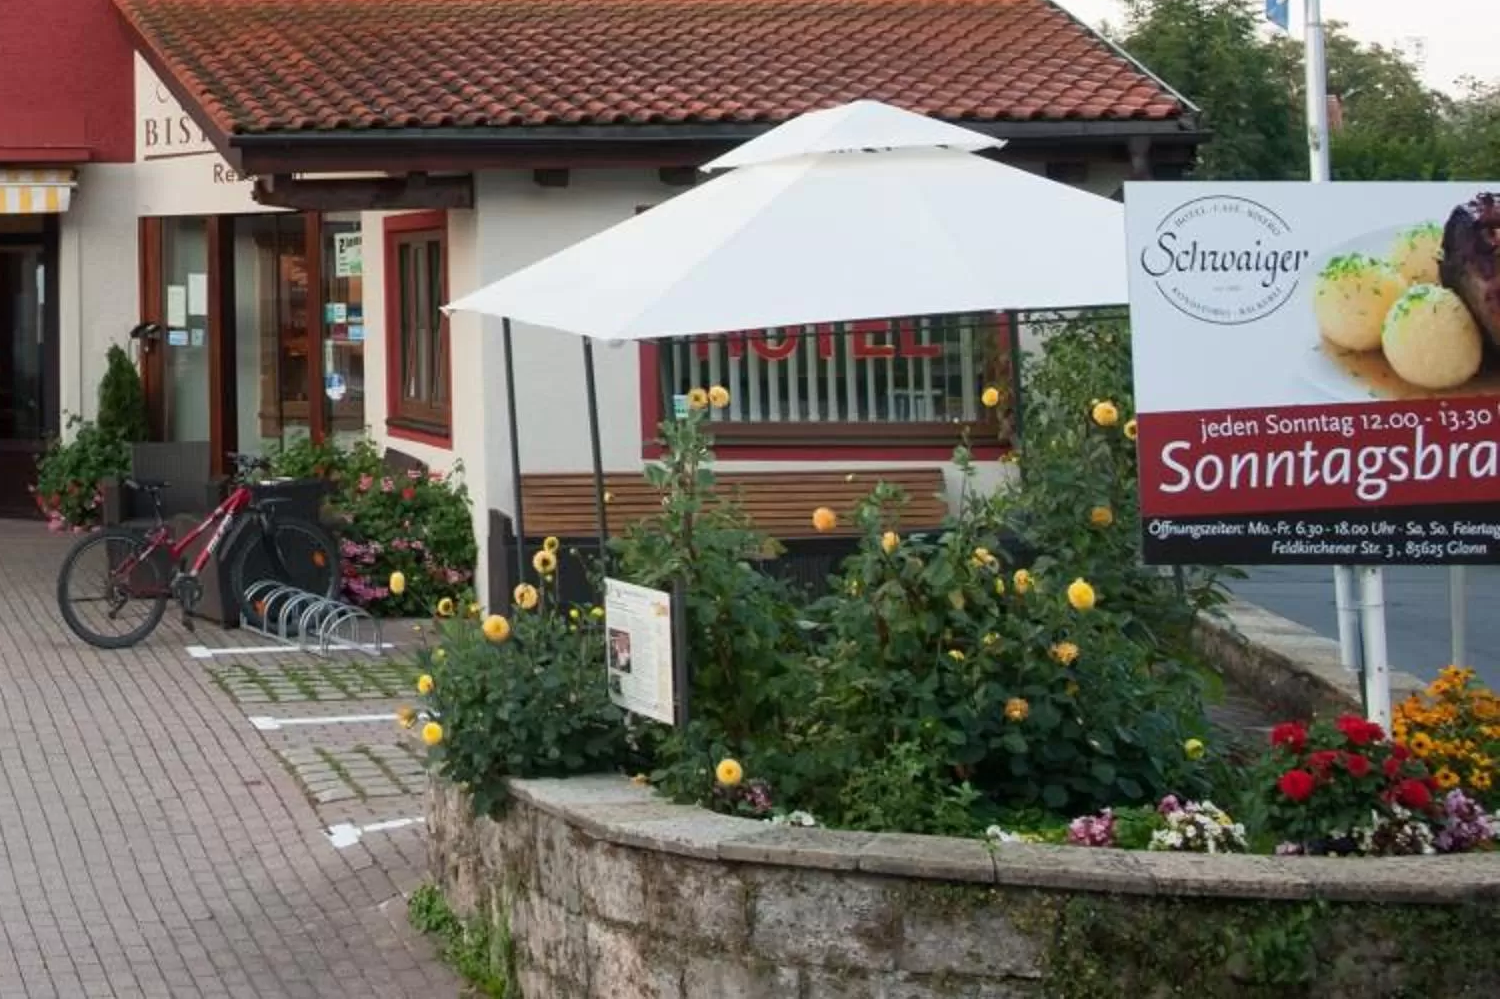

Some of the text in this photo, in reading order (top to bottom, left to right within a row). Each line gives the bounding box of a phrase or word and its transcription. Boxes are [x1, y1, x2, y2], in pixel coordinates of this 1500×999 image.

[145, 115, 210, 147] BIS
[1140, 231, 1309, 288] Schwaiger
[1201, 417, 1259, 444] jeden
[1265, 413, 1356, 437] Sonntag
[1359, 412, 1419, 430] 12.00
[1159, 424, 1500, 502] Sonntagsbra
